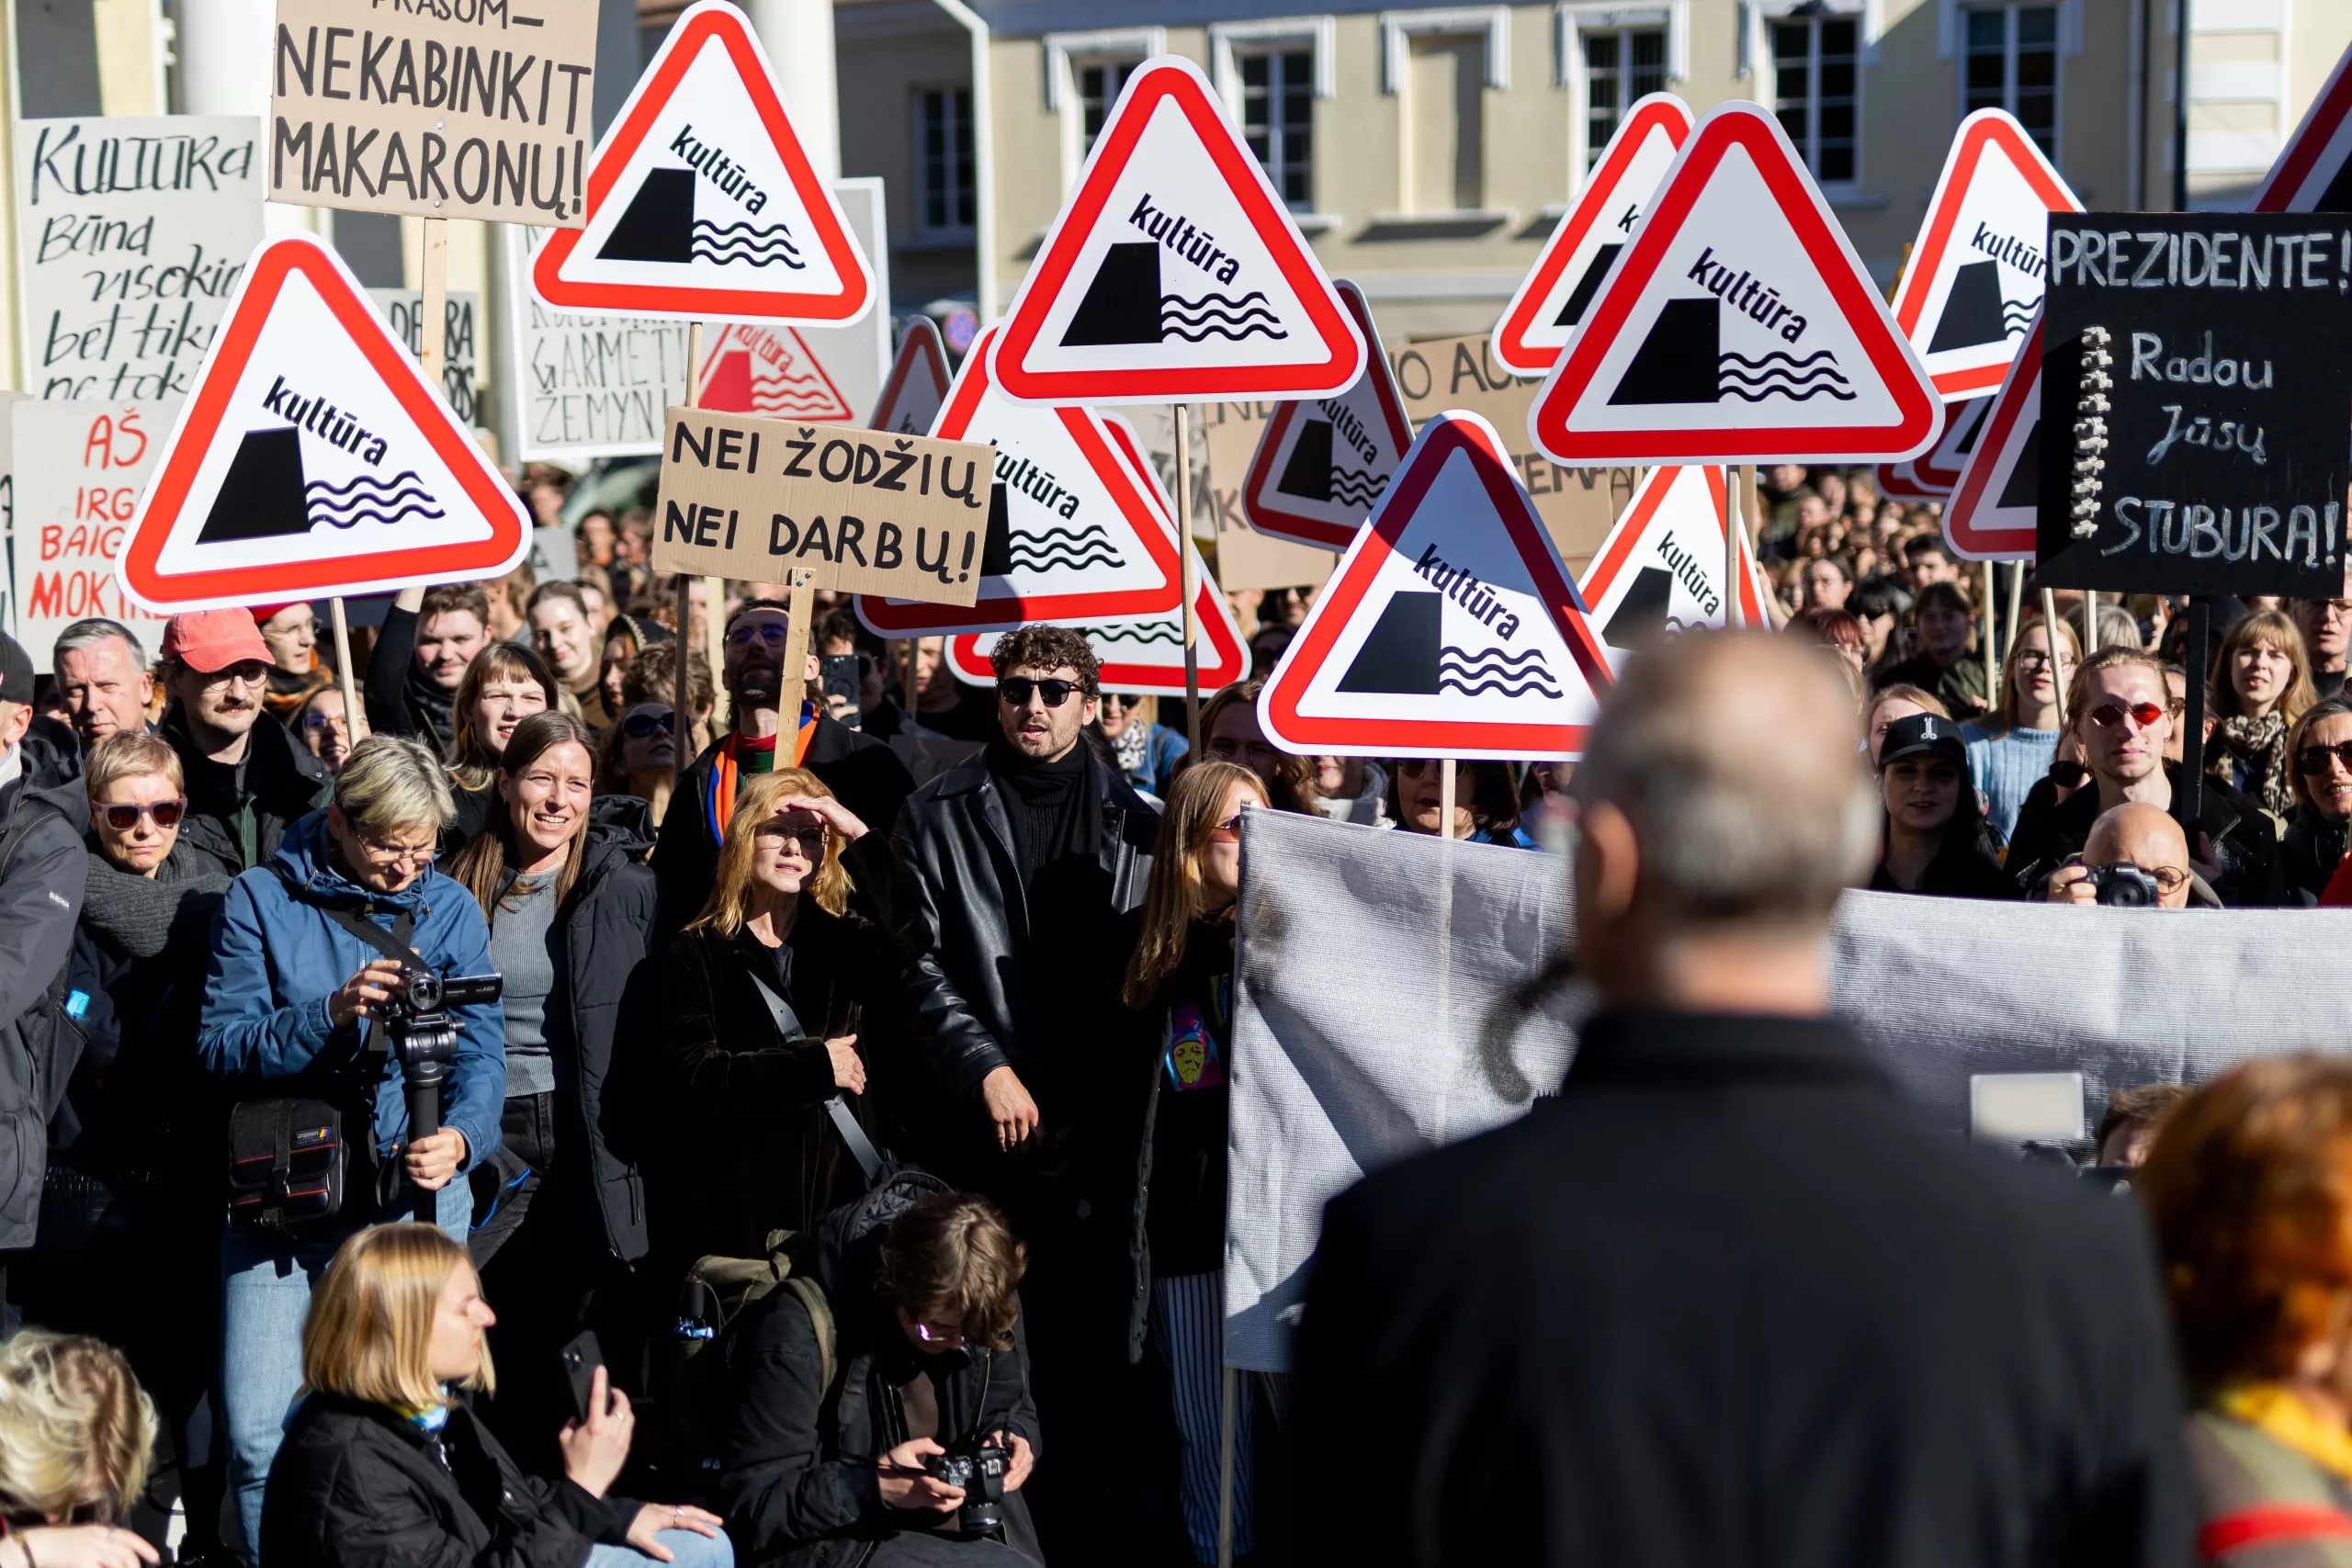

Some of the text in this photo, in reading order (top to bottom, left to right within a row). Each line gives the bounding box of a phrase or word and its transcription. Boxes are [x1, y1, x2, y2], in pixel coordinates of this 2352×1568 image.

[277, 23, 593, 135] NEKABINKIT
[274, 116, 584, 220] MAKARONŲ!
[669, 123, 768, 217] kultūra
[1128, 192, 1241, 287] kultūra
[1971, 220, 2048, 282] kultūr
[2051, 227, 2352, 294] PREZIDENTE!
[43, 300, 219, 367] bet tik
[1688, 246, 1808, 344] kultūra
[108, 360, 197, 400] tok
[2130, 329, 2274, 389] Radau
[84, 407, 148, 470] AŠ
[262, 374, 389, 467] kultūra
[2145, 404, 2267, 466] Jūsų
[75, 486, 146, 523] IRG
[672, 421, 982, 509] NEI ŽODŽIŲ
[989, 437, 1080, 522] ultūra
[663, 499, 977, 584] NEI DARBŲ!
[1657, 529, 1720, 618] kultūra
[2100, 496, 2340, 570] STUBURĄ!
[1413, 542, 1521, 641] kultūra
